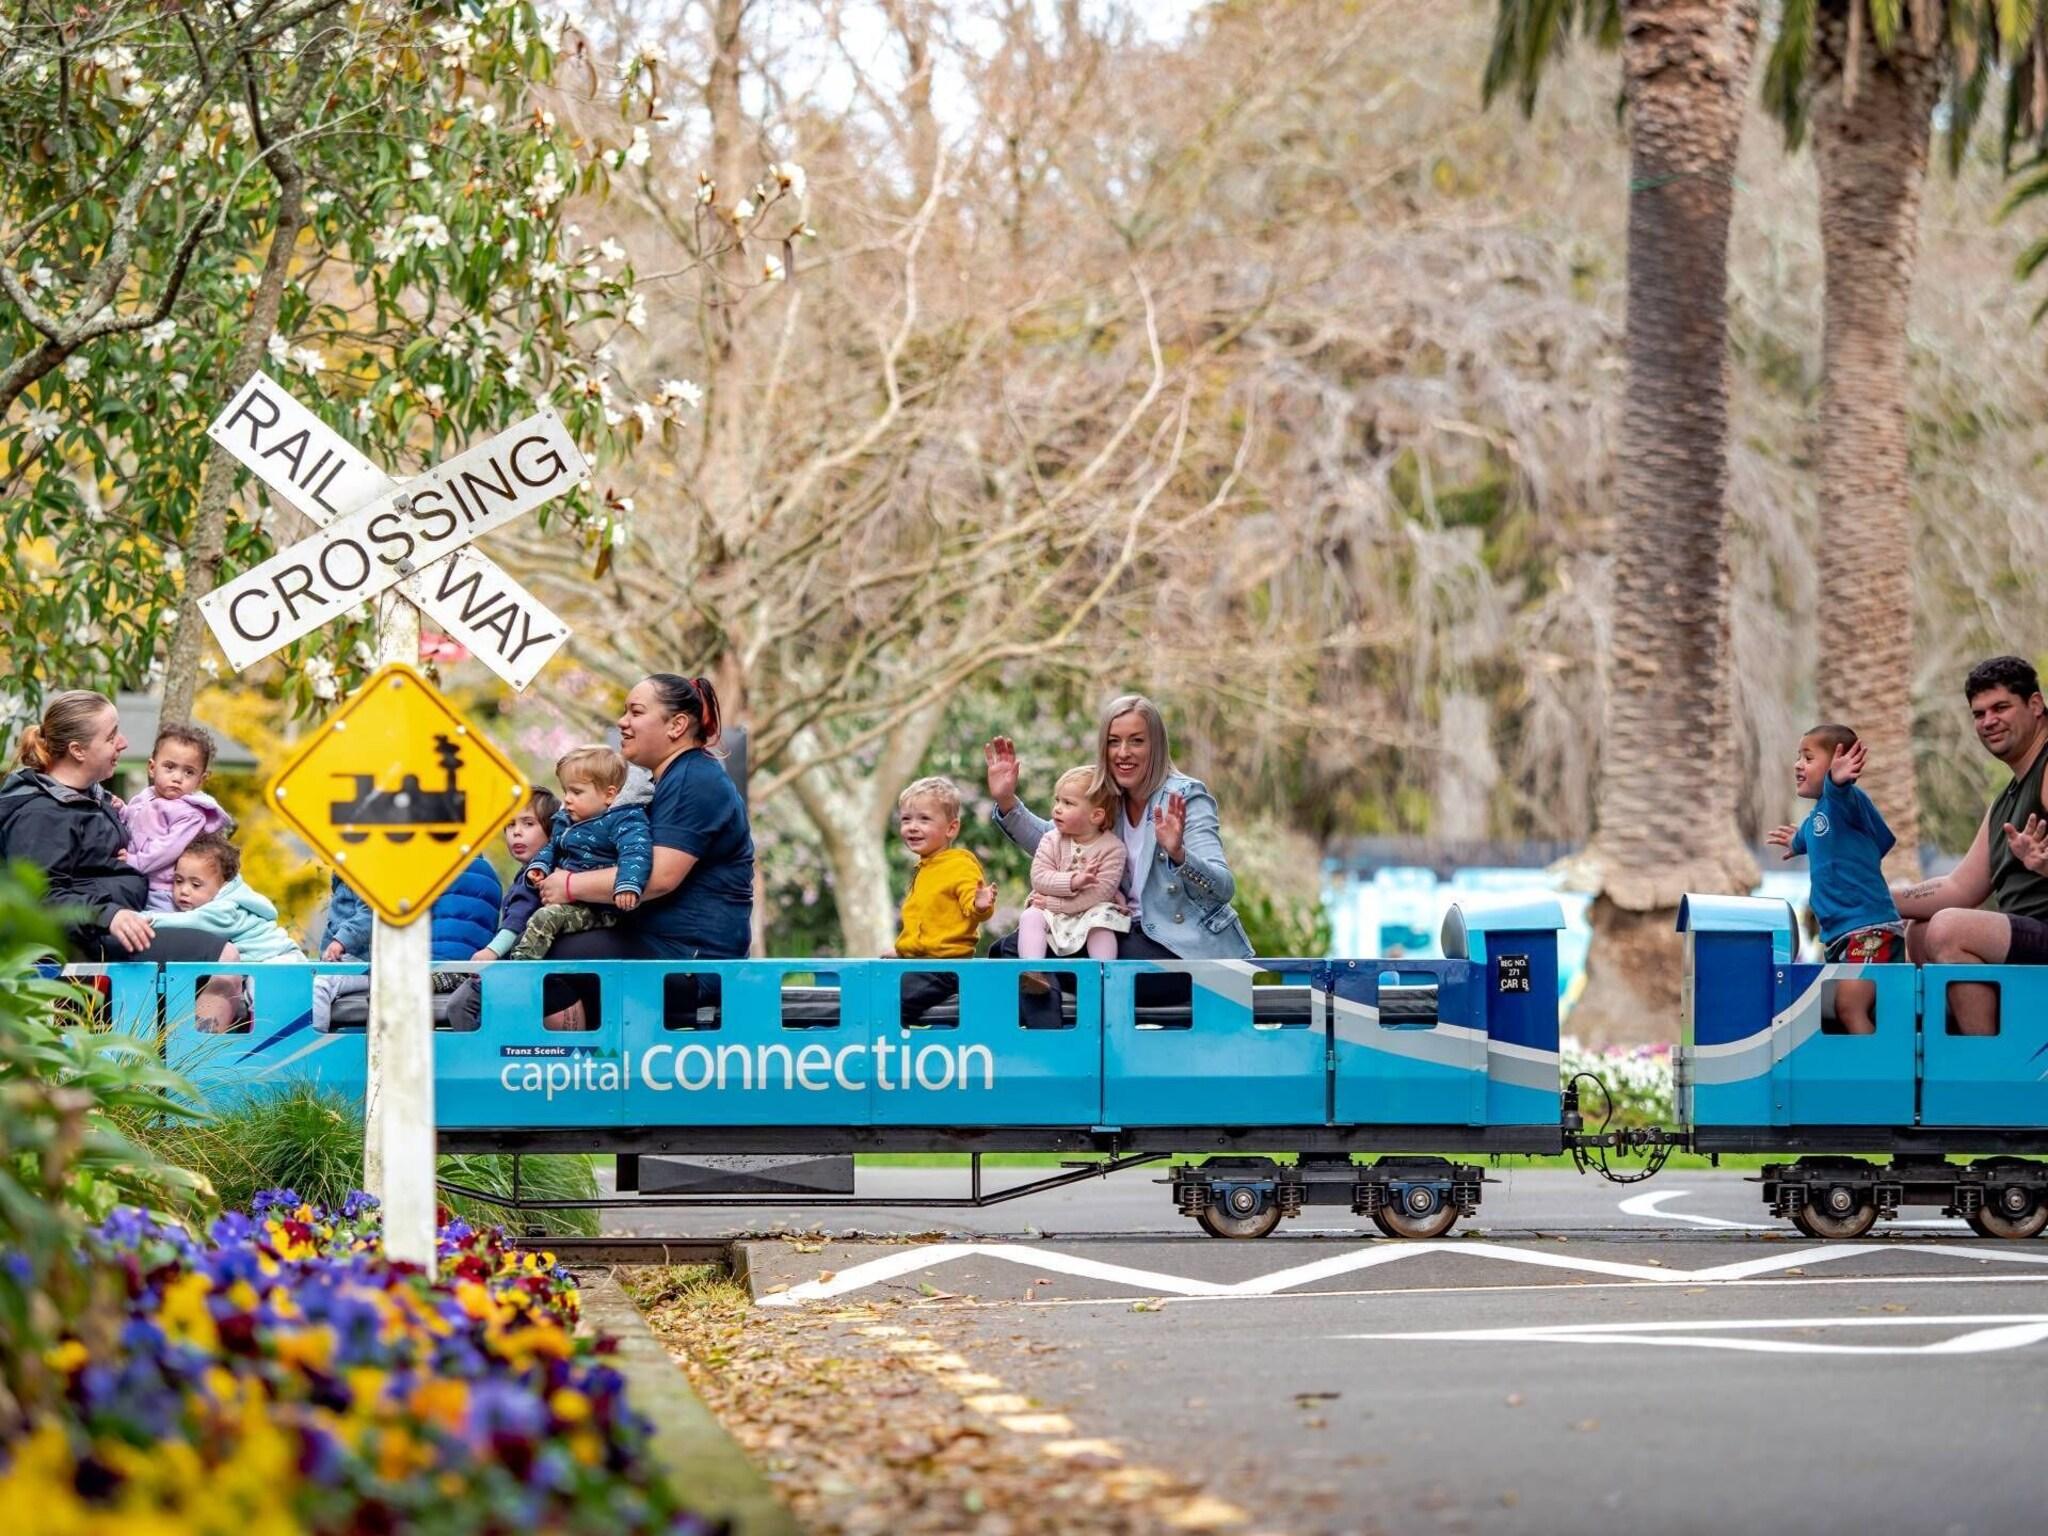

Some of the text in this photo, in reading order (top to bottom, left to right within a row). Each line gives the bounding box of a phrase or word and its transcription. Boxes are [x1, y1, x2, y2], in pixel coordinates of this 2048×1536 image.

[225, 388, 556, 665] RAIL WAY
[229, 435, 569, 642] CROSSING
[1500, 959, 1513, 967] REG
[1508, 968, 1520, 976] 271
[1500, 978, 1529, 989] CAR B
[505, 1046, 566, 1055] Tranz Scenic
[500, 1029, 994, 1102] capital connection
